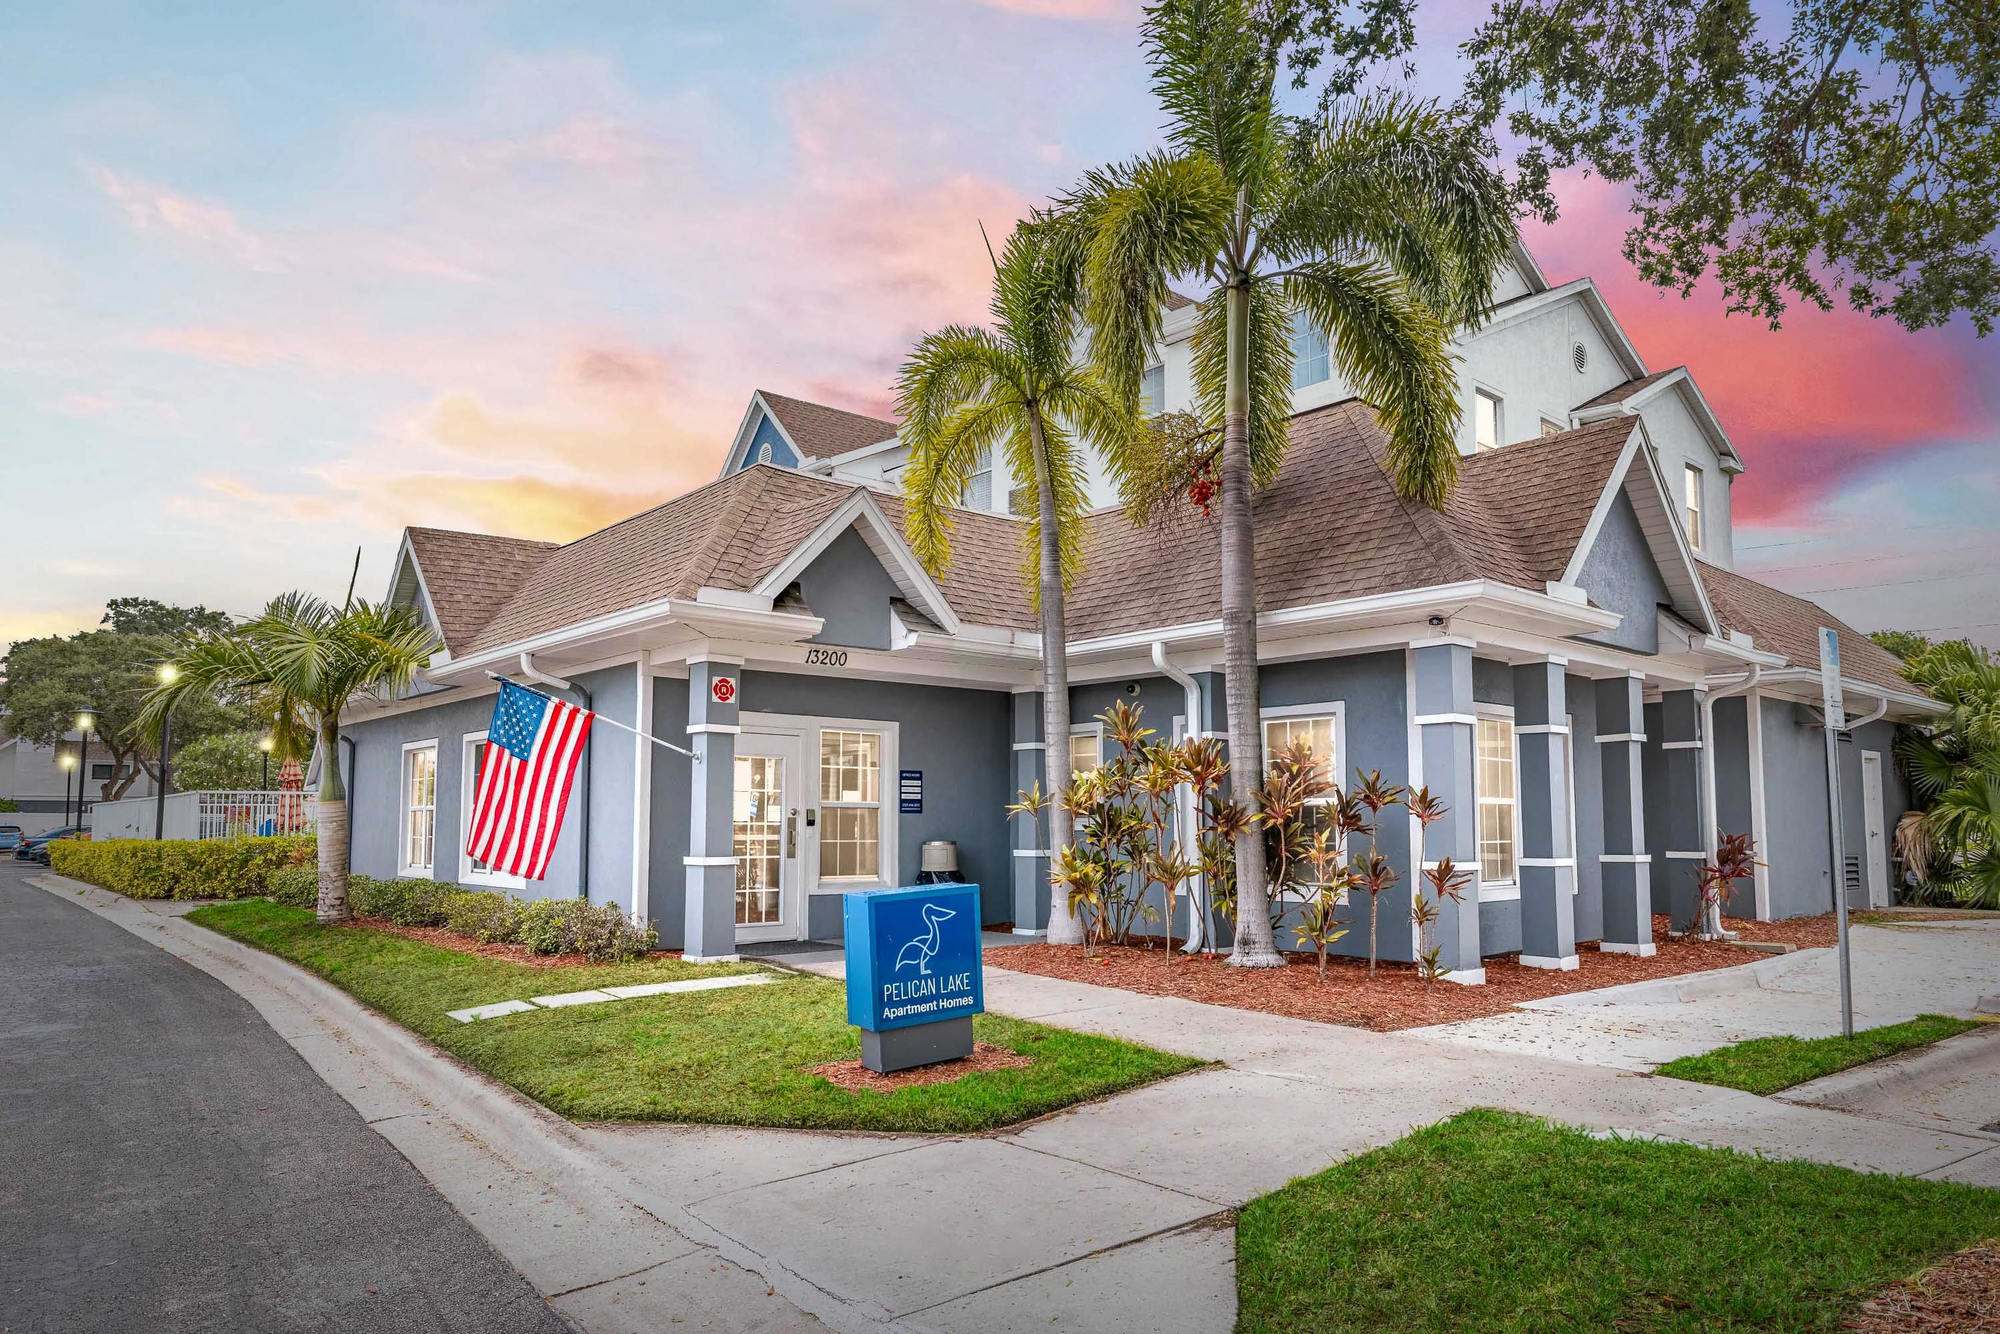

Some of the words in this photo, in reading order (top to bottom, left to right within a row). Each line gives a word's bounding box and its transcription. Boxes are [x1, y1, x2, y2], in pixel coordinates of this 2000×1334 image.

[805, 649, 847, 666] 13200
[884, 978, 936, 1002] PELICAN
[940, 972, 971, 993] LAKE
[883, 1001, 937, 1019] Apartment
[939, 996, 974, 1009] Homes
